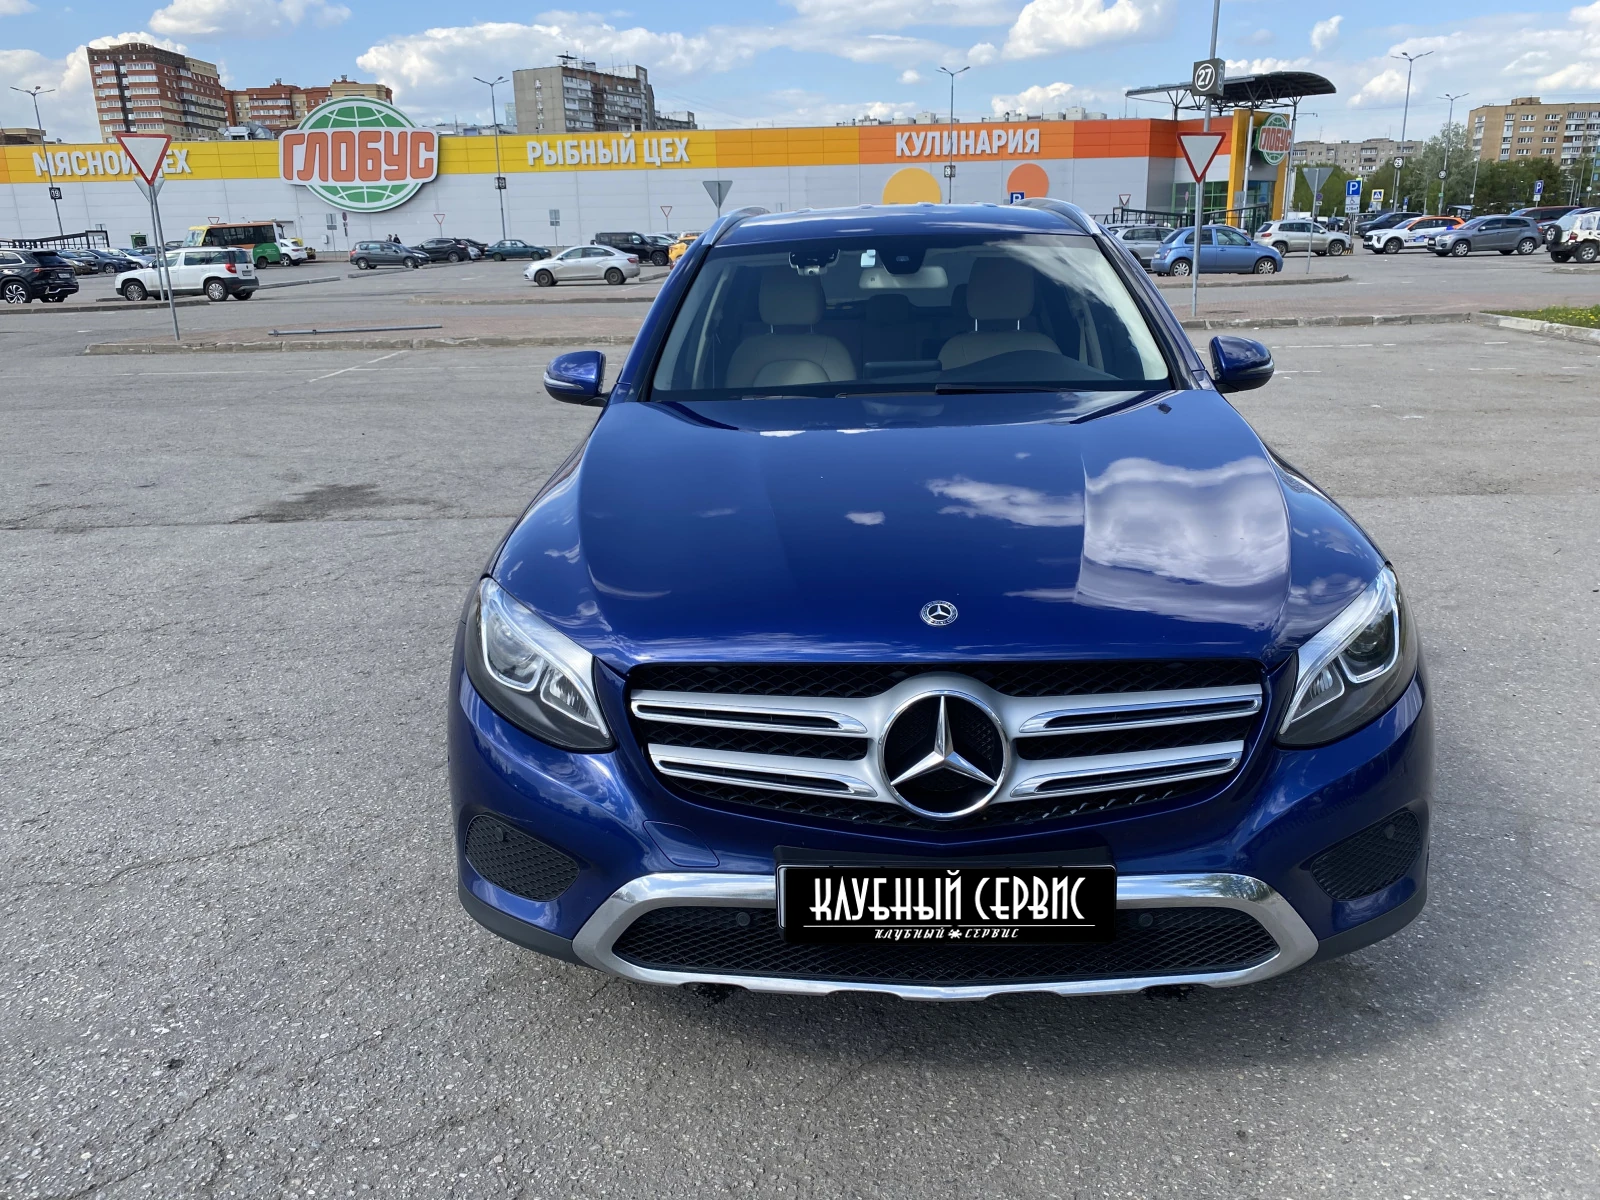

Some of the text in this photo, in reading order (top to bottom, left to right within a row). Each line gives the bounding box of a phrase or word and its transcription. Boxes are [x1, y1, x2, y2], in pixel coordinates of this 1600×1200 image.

[1197, 68, 1213, 86] 27
[526, 132, 690, 167] РЫБНЫЙ ЦЕХ
[895, 128, 1040, 157] КУЛИНАРИЯ
[1259, 128, 1292, 152] ГЛОБУС
[159, 149, 192, 177] ЕХ
[283, 130, 435, 182] ГЛОБУС
[1349, 181, 1358, 195] P
